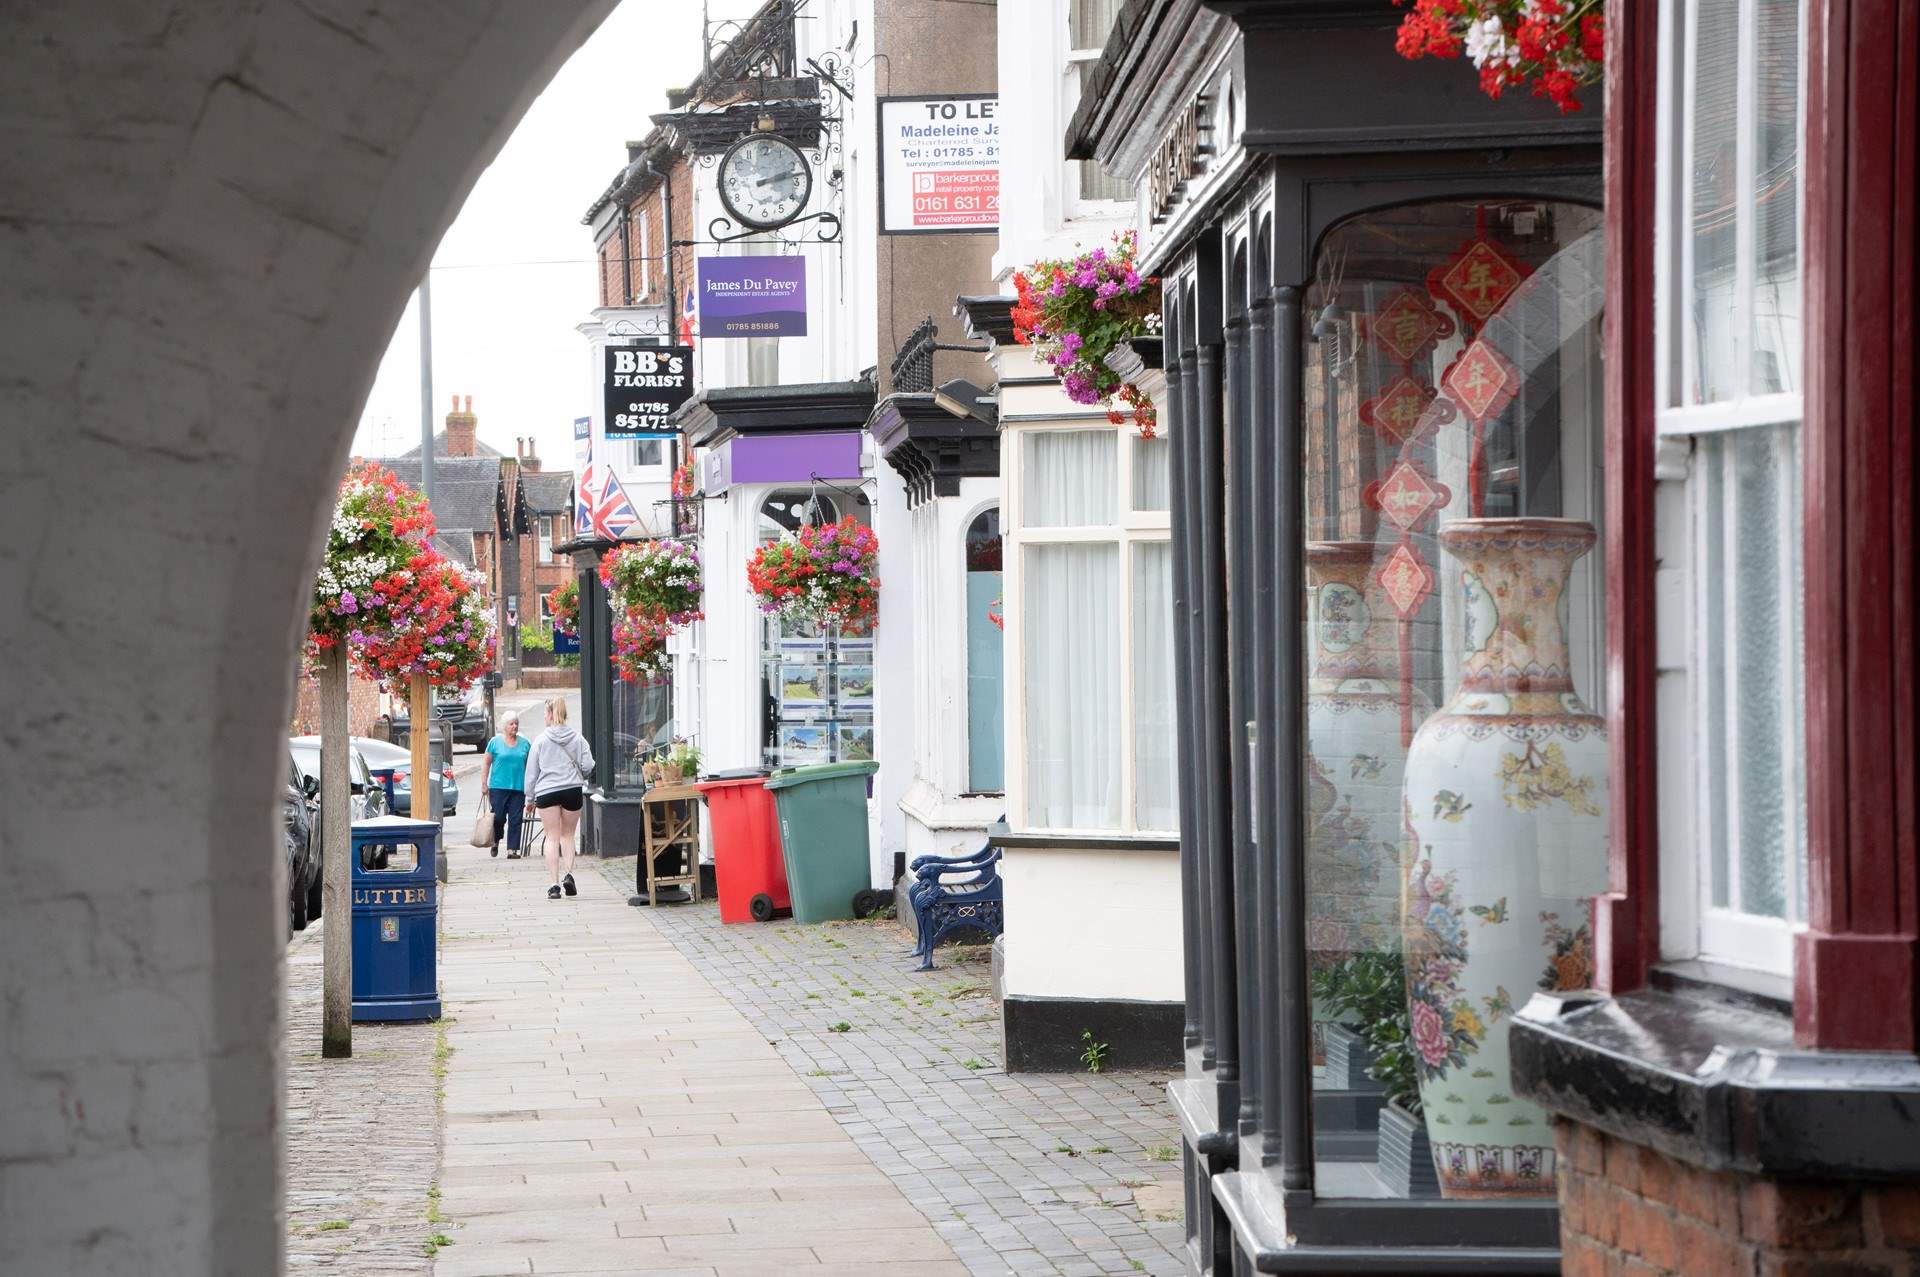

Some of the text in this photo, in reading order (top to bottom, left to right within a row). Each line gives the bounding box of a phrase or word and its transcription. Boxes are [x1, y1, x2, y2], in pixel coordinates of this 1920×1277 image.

[925, 102, 999, 120] TO LE
[901, 124, 979, 138] Madeleine
[901, 149, 921, 159] Tel
[933, 147, 974, 158] 01785
[729, 177, 736, 187] 9
[793, 177, 800, 187] 3
[734, 193, 741, 203] 8
[915, 196, 948, 211] 0161
[954, 196, 980, 210] 631
[747, 203, 754, 214] 7
[762, 208, 768, 218] 6
[778, 203, 784, 214] 5
[706, 278, 798, 293] James Du Pavey
[614, 375, 685, 387] FLORIST
[629, 402, 669, 414] 01785
[354, 888, 426, 904] LITTER
